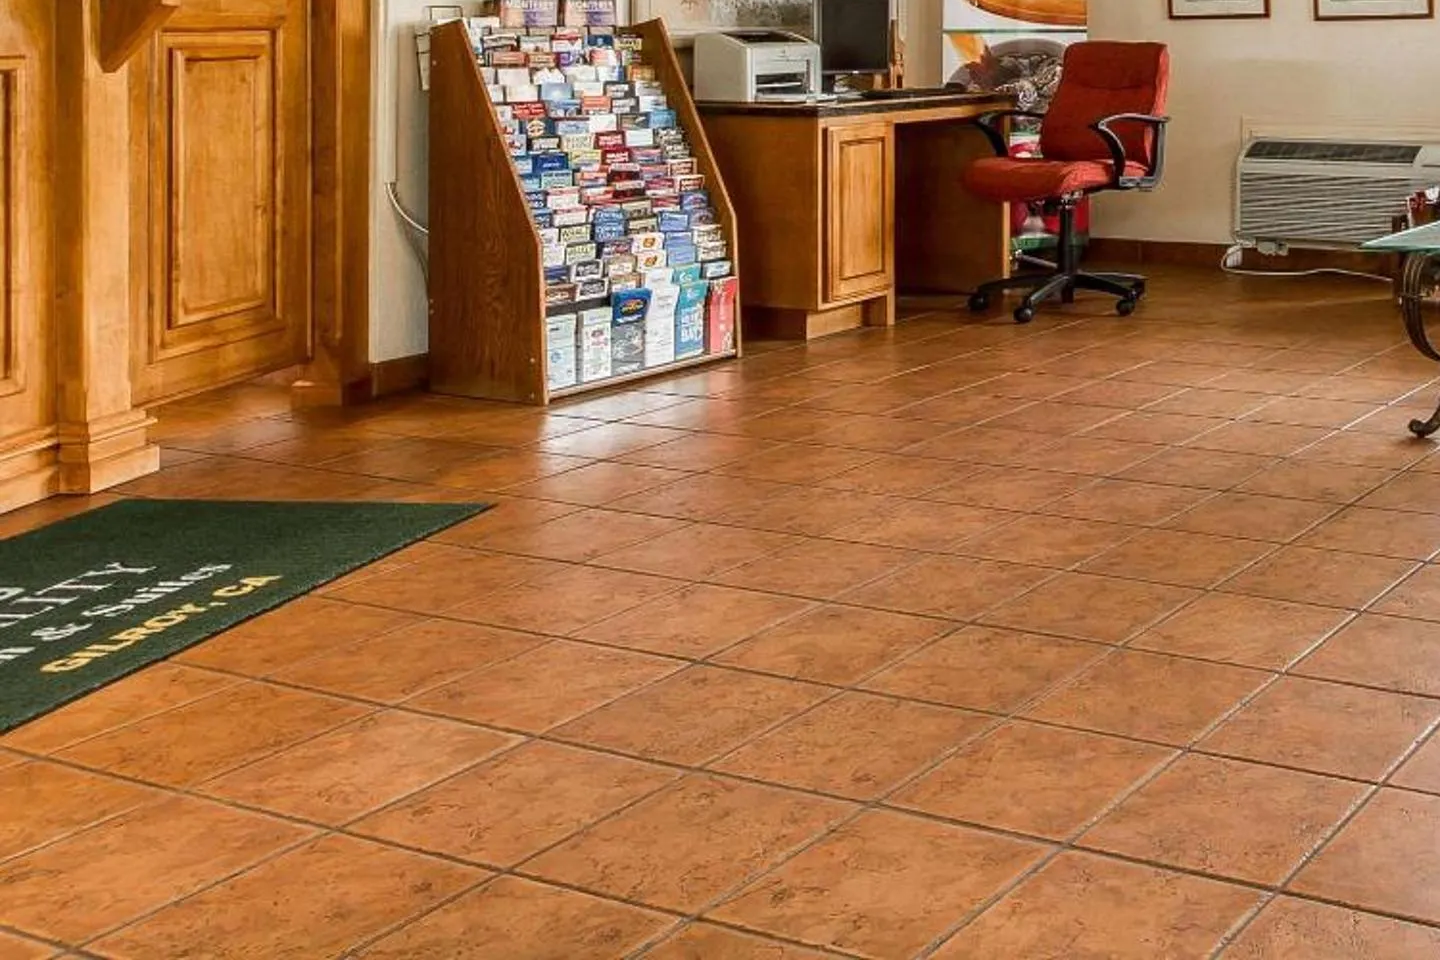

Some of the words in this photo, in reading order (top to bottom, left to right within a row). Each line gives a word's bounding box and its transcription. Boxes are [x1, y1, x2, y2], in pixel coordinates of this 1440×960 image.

[30, 622, 93, 641] &
[81, 563, 233, 617] Suites
[212, 574, 284, 597] CA
